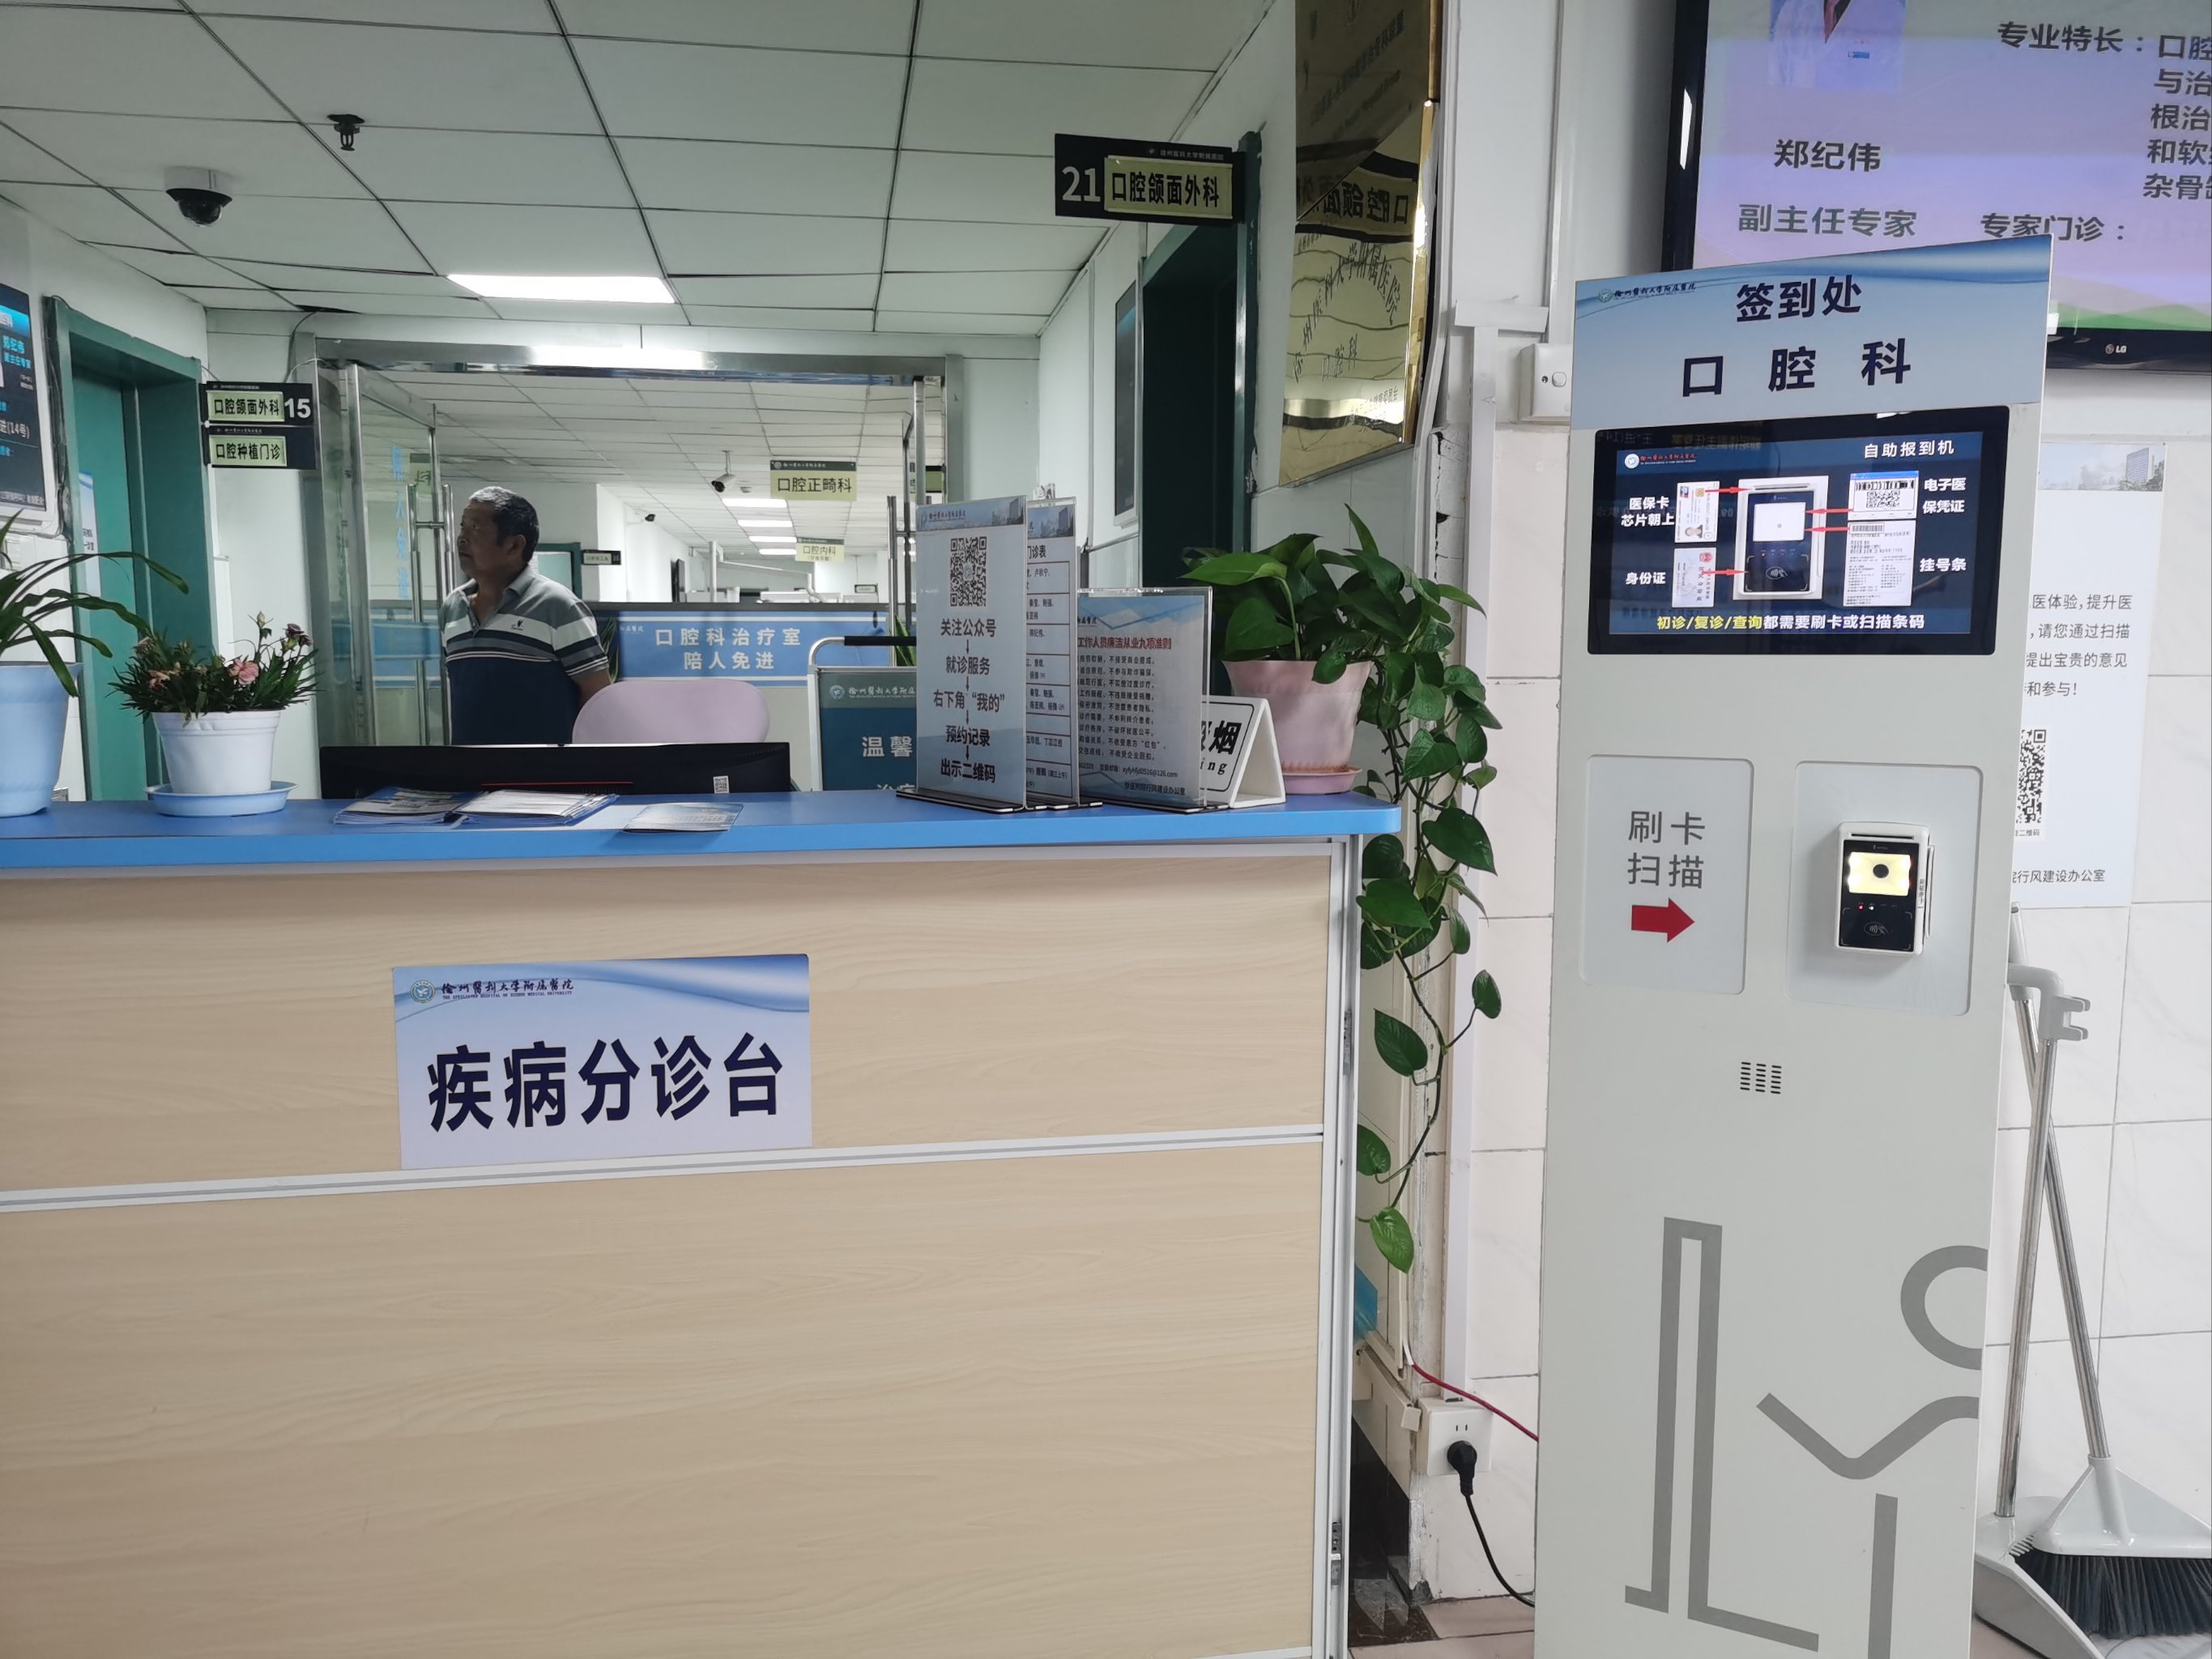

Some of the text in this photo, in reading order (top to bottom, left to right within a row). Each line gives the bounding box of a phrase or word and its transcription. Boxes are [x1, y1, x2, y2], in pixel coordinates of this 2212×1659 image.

[2150, 104, 2210, 131] 根治
[1774, 139, 1882, 172] 郑纪伟
[2146, 138, 2212, 166] 和软
[1061, 165, 1220, 207] 21 口腔颌面外科
[1738, 203, 1917, 237] 副主任专家
[1736, 274, 1863, 322] 签到处
[2116, 345, 2127, 353] LG
[1681, 338, 1911, 397] 口腔科
[214, 398, 311, 419] 口腔颌面外科 15
[215, 442, 281, 460] 口腔种植门诊
[1865, 440, 1954, 458] 自助报到机
[778, 477, 851, 493] 口腔正畸科
[1924, 477, 1967, 491] 电子医
[1629, 497, 1669, 510] 医保卡
[1922, 501, 1965, 514] 保凭证
[1621, 514, 1674, 527] 芯片朝上
[803, 545, 836, 556] 口腔内科
[1920, 558, 1967, 573] 挂号条
[1626, 572, 1666, 585] 身份证
[940, 618, 996, 638] 关注公众号
[1657, 614, 1924, 630] 初诊/复诊/查询都需要刷卡或扫描条码
[655, 627, 801, 646] 口腔科治疗室
[684, 651, 774, 671] 陪人免进
[945, 655, 991, 676] 就诊服务
[2025, 681, 2078, 697] 和参与！
[862, 735, 913, 757] 温馨
[945, 725, 991, 747] 预约记录
[940, 758, 996, 783] 出示二维码
[1628, 810, 1706, 845] 刷卡
[1627, 852, 1704, 889] 扫描
[428, 1031, 782, 1132] 疾病分诊台
